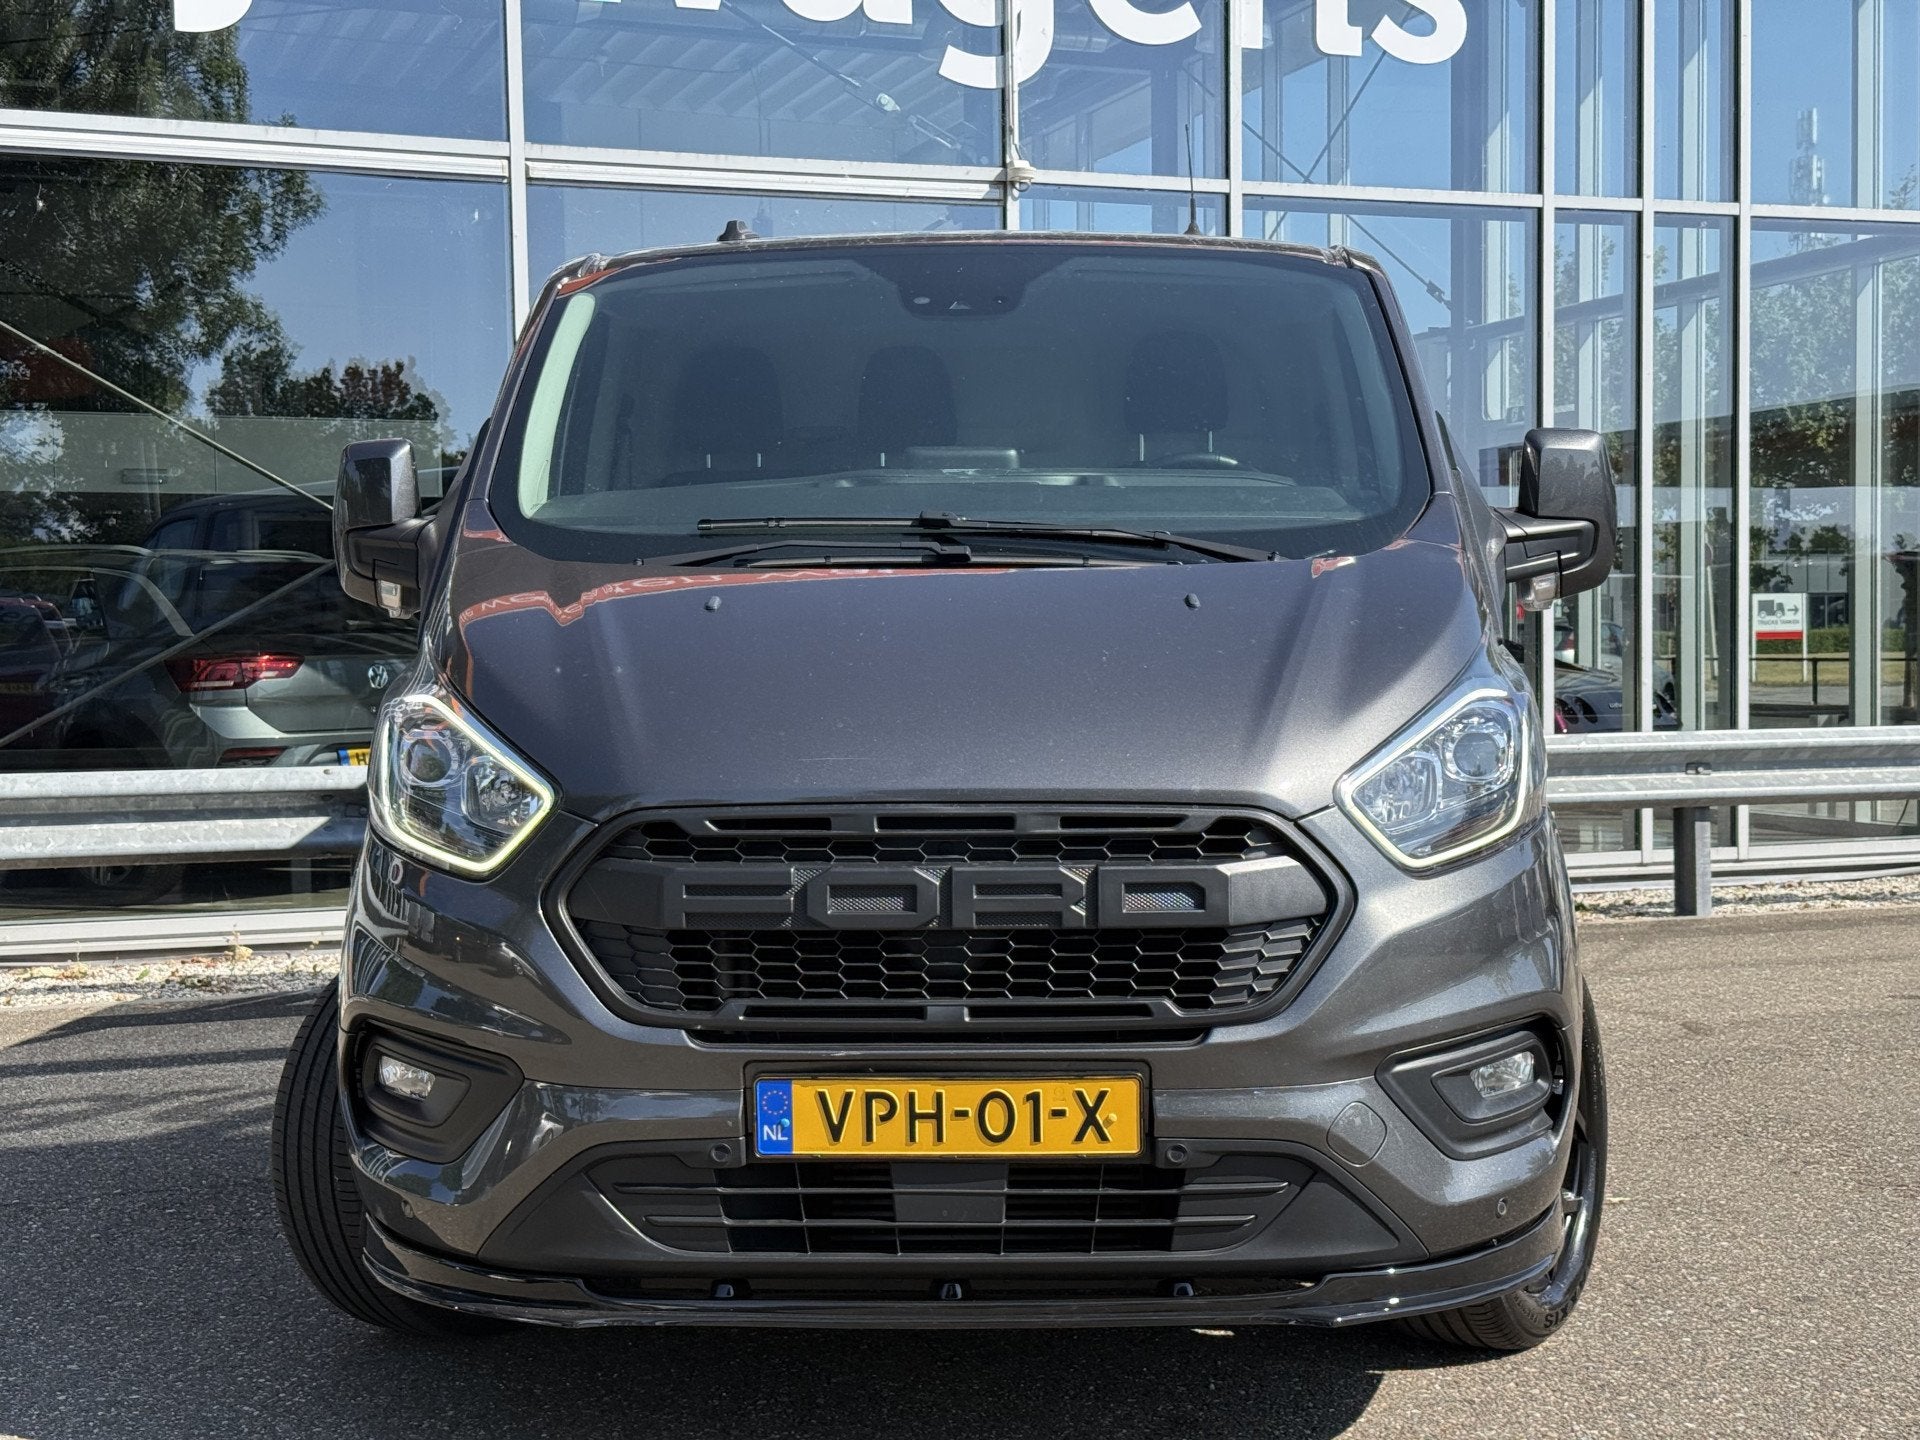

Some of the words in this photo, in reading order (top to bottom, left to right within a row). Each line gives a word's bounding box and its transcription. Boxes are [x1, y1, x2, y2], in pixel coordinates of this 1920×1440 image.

[663, 863, 1232, 930] FORD
[763, 1124, 789, 1141] NL
[816, 1088, 1111, 1145] VPH-01-X
